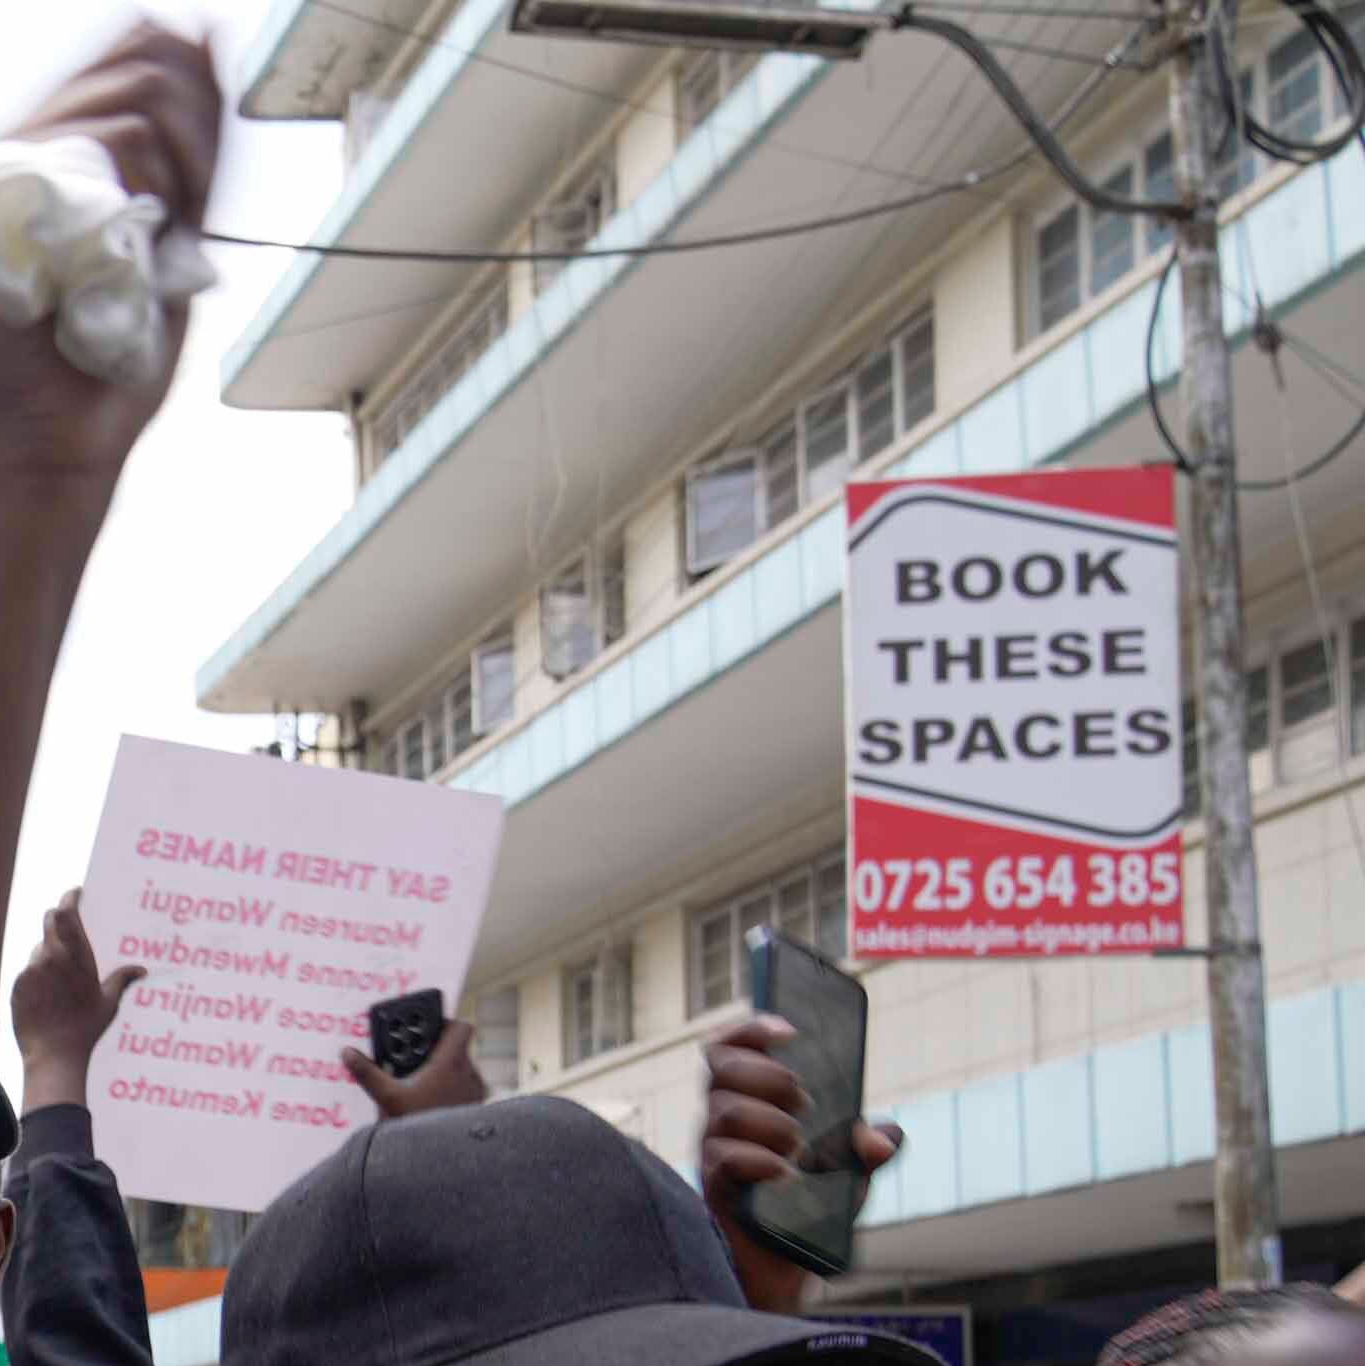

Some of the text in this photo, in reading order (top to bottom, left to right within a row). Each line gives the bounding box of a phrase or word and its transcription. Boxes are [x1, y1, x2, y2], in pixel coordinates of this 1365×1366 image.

[895, 548, 1129, 606] BOOK
[876, 628, 1148, 686] THESE
[857, 708, 1173, 766] SPACES
[853, 852, 1180, 913] 0725 654 385
